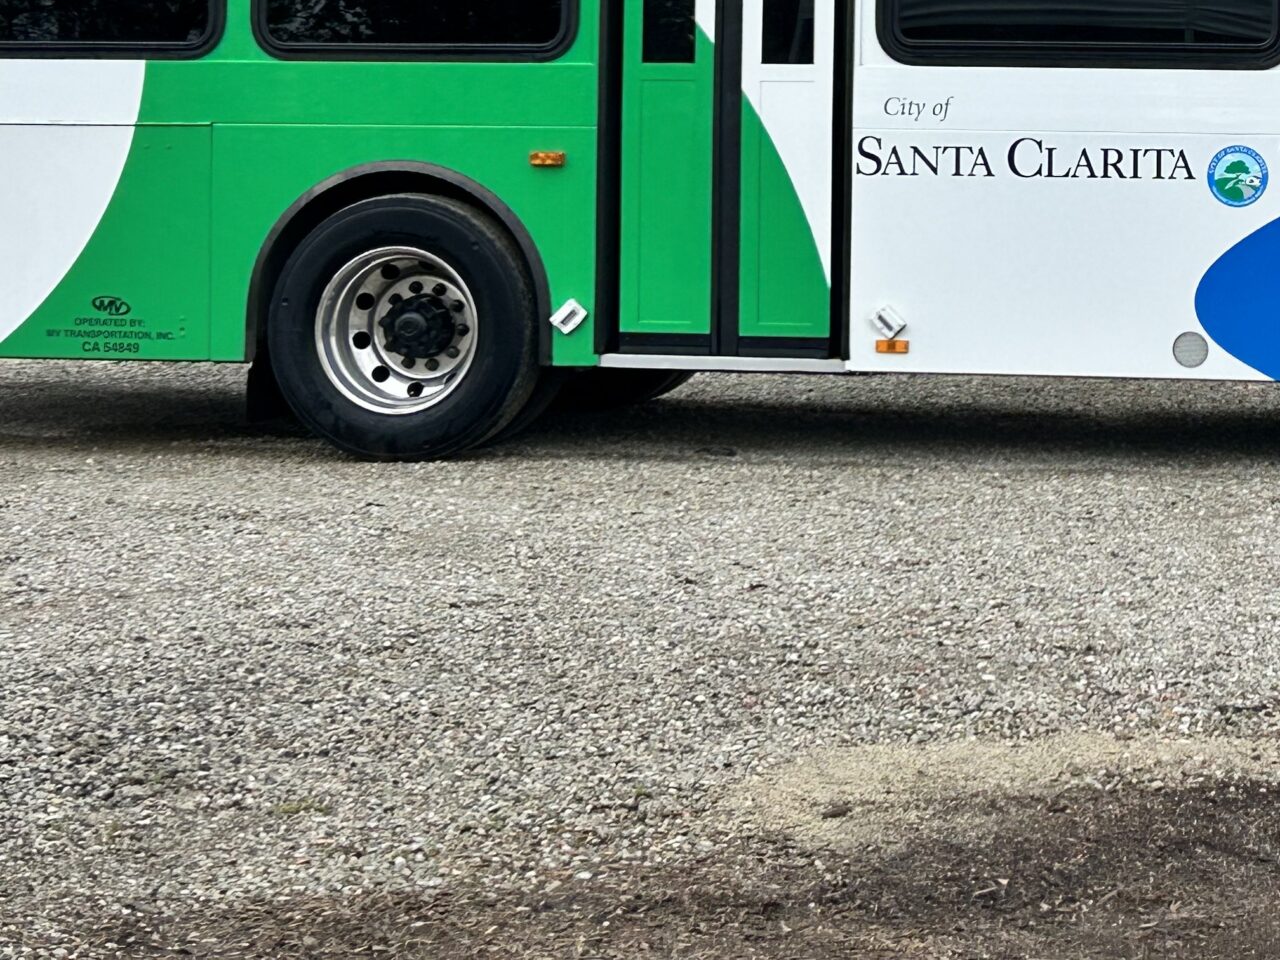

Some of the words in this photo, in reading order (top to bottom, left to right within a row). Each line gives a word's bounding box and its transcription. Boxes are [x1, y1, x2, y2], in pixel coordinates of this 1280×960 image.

[884, 97, 926, 121] City
[932, 96, 955, 122] of
[856, 135, 996, 178] SANTA
[1007, 137, 1196, 181] CLARITA
[74, 317, 127, 327] OPERATED
[82, 341, 100, 352] CA
[103, 341, 140, 353] 54849
